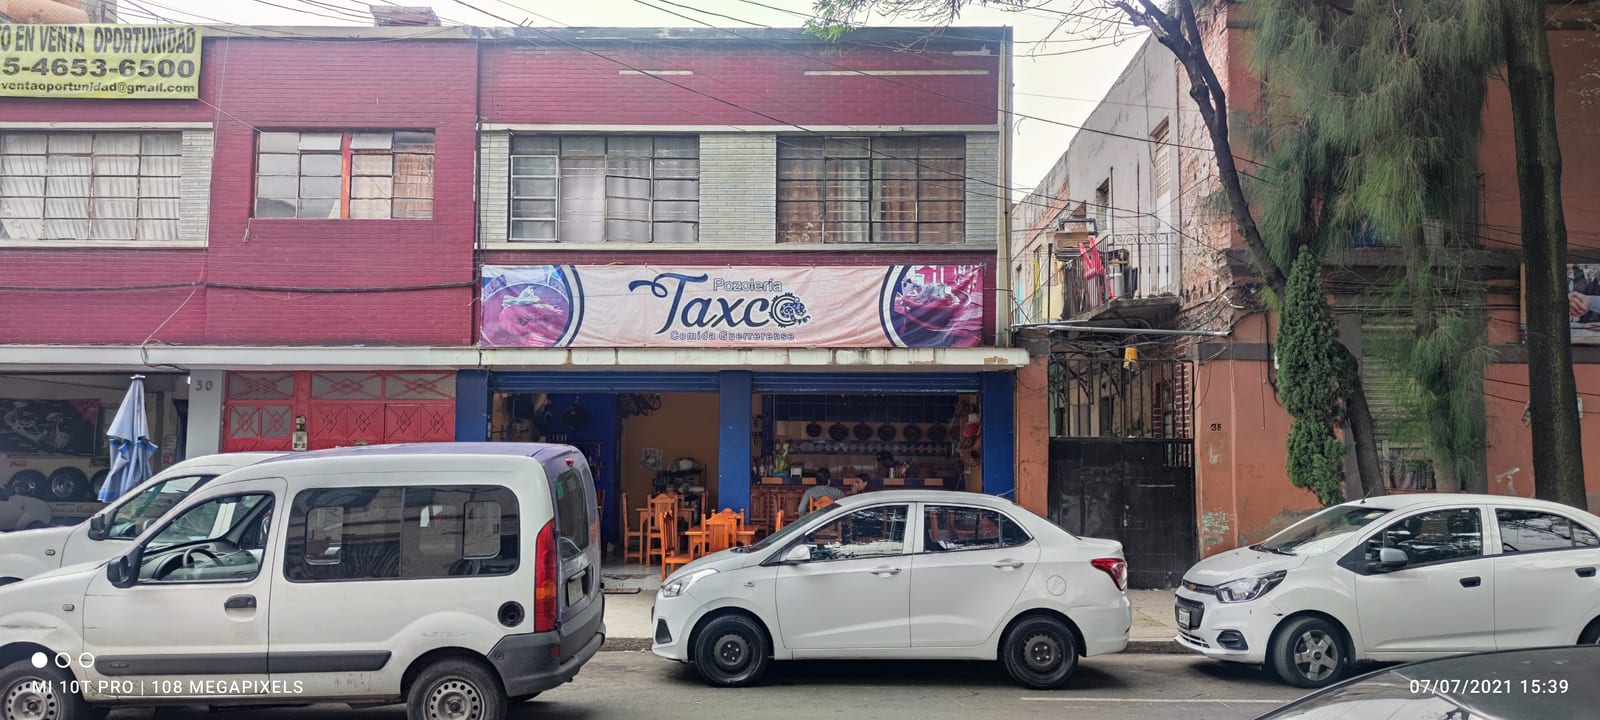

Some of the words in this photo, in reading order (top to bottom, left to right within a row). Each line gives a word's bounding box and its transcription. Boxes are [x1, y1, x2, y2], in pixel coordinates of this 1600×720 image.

[15, 26, 35, 51] EN
[40, 26, 85, 53] VENTA
[94, 27, 196, 54] OPORTUNIDAD
[2, 57, 195, 78] 5-4653-6500
[1, 81, 195, 94] ventaoportunidad@gmail.com
[713, 278, 783, 292] Pozolería
[628, 272, 811, 335] Taxco
[670, 330, 716, 341] Comida
[718, 330, 795, 341] Guerrerense
[195, 380, 213, 392] 30
